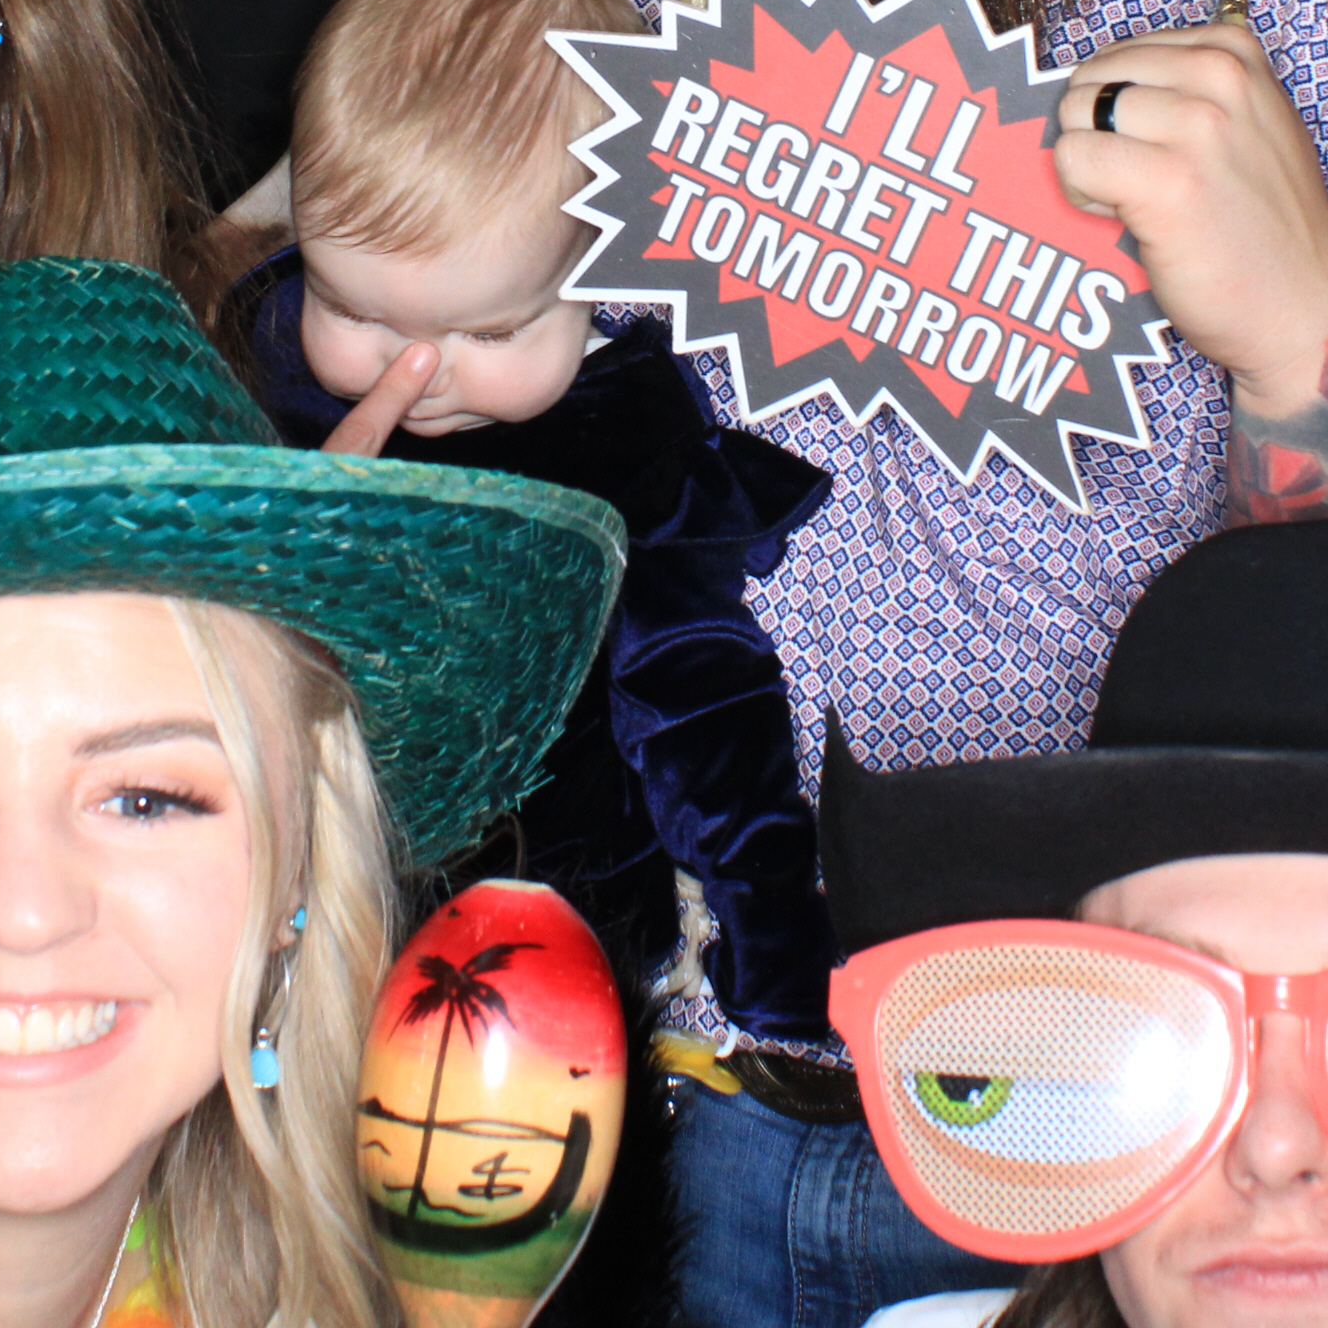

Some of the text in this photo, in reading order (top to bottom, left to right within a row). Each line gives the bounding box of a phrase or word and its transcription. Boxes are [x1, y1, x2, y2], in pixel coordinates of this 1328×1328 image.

[651, 77, 1127, 351] REGRET THIS
[657, 173, 1076, 416] TOMORROW
